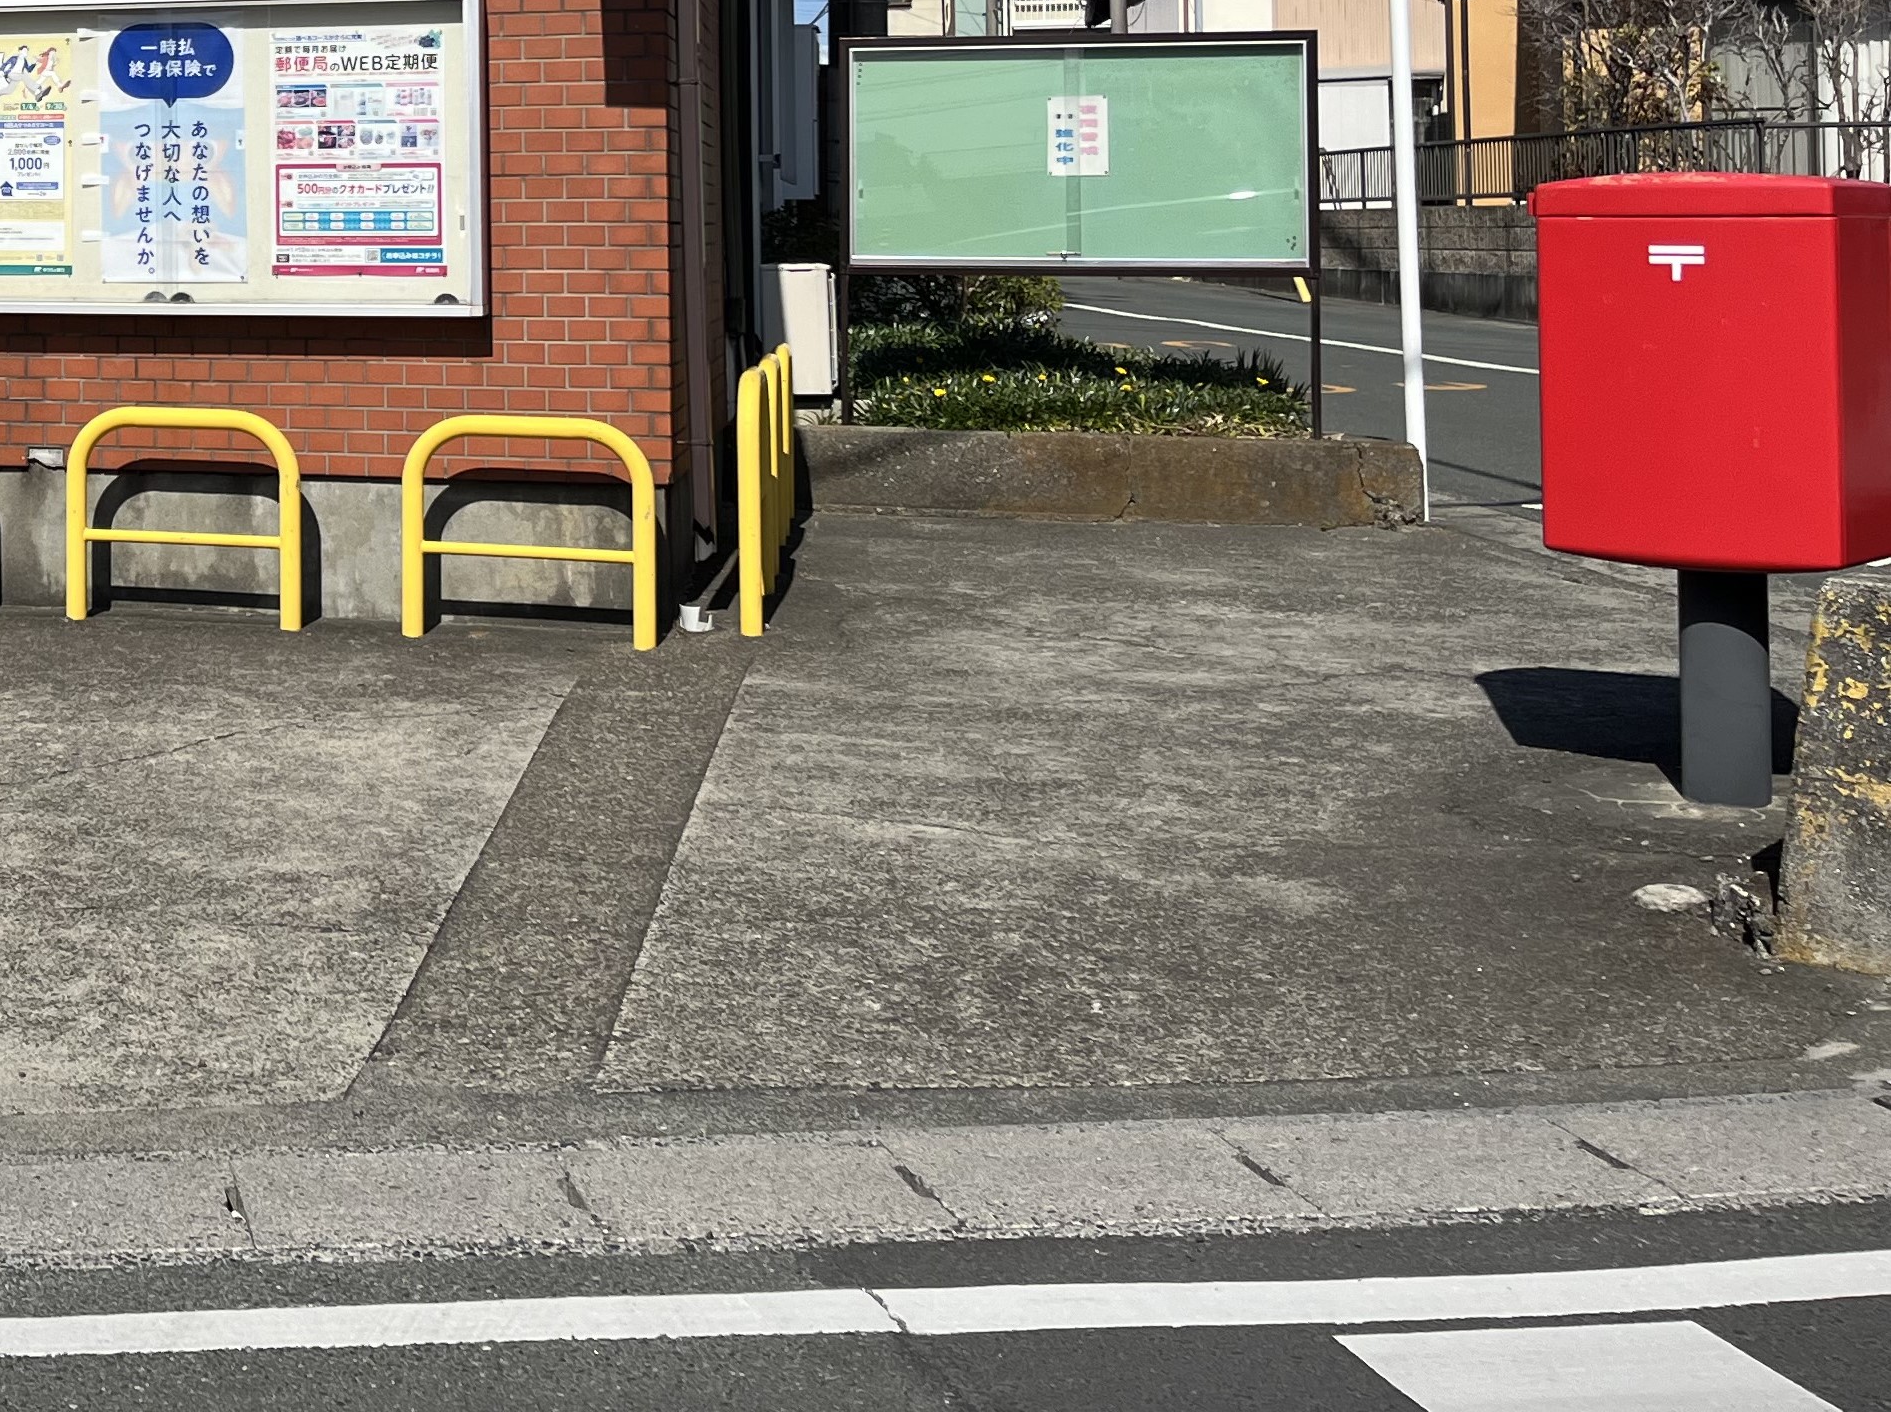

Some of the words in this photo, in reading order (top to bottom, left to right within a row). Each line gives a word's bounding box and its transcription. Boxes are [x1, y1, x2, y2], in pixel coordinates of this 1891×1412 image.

[128, 59, 217, 78] 終身保険で
[140, 38, 195, 57] 一時払
[275, 53, 439, 73] 郵便局のWEB定期便
[134, 123, 156, 276] つなげませんか。
[161, 119, 182, 222] 大切な人へ
[191, 121, 211, 266] あなたの想いを
